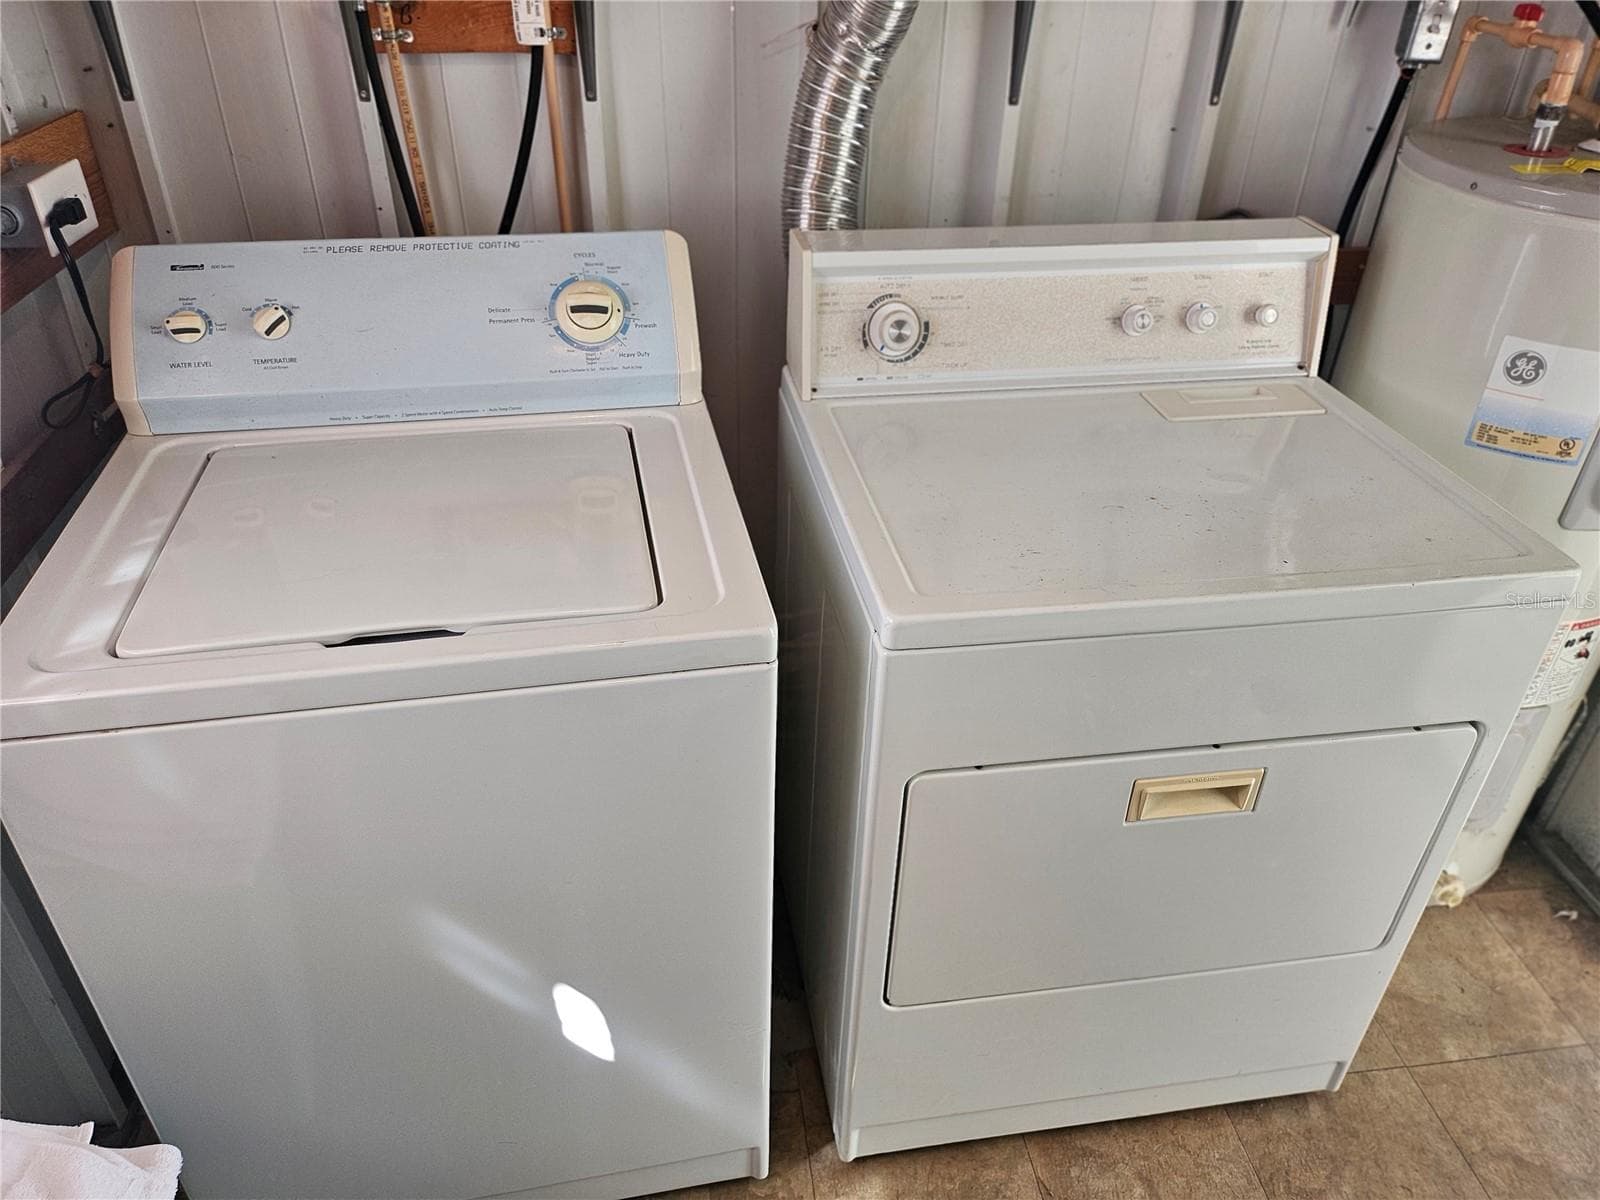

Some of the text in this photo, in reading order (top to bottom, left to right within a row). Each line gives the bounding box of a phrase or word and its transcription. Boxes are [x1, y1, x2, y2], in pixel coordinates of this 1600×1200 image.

[325, 245, 363, 254] PLEASE
[369, 243, 406, 252] REMOVE
[413, 242, 473, 252] PROTECTIVE
[478, 241, 520, 249] COATING
[253, 357, 297, 365] TEMPERATURE
